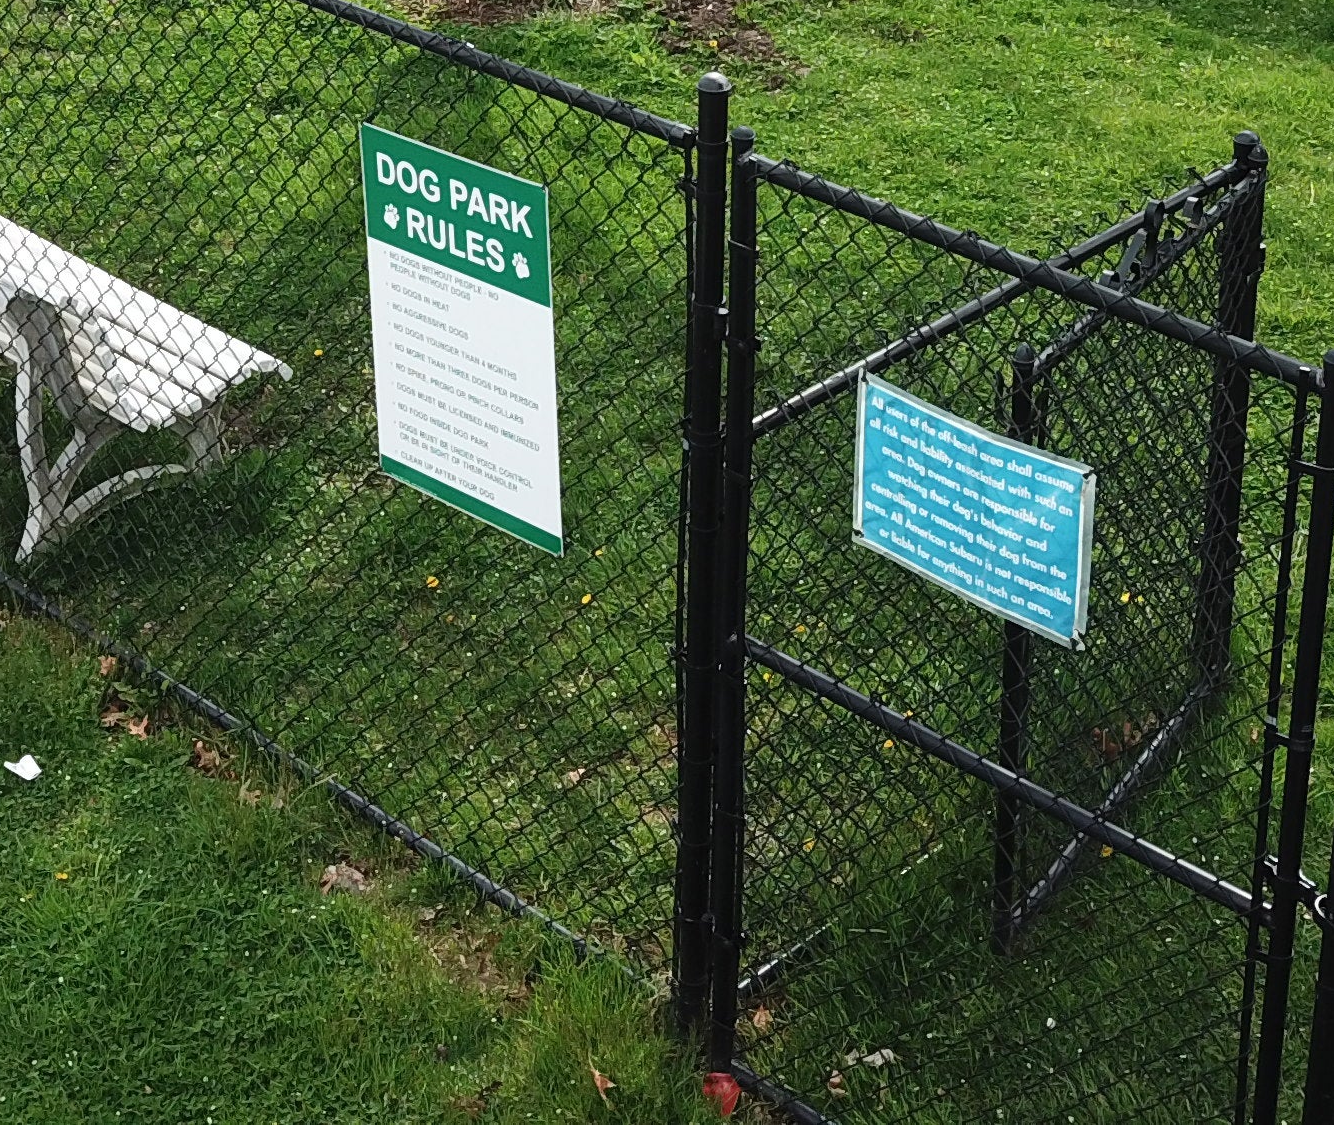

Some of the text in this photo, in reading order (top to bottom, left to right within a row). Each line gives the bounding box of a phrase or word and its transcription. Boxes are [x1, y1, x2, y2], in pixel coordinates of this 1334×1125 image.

[376, 151, 533, 239] DOG PARK
[406, 206, 505, 273] RULES
[870, 418, 881, 430] all
[883, 424, 898, 439] risk
[901, 435, 918, 449] and
[955, 462, 1005, 491] associated
[1008, 486, 1031, 499] with
[1035, 495, 1057, 510] such
[1058, 505, 1073, 517] an
[872, 396, 884, 410] All
[886, 406, 908, 423] users
[910, 417, 920, 428] of
[921, 421, 936, 436] the
[980, 453, 1004, 468] area
[1007, 460, 1032, 477] shall
[1035, 473, 1075, 493] assume
[871, 483, 1067, 580] controlling or removing their dog from the
[888, 470, 928, 499] watching
[930, 489, 950, 507] their
[981, 513, 1023, 542] behavior
[1026, 538, 1047, 552] and
[907, 456, 926, 477] Dog
[928, 470, 961, 492] owners
[963, 487, 979, 500] are
[981, 496, 1038, 526] responsible
[1040, 517, 1055, 532] for
[879, 529, 889, 538] or
[891, 531, 916, 553] liable
[917, 545, 930, 560] for
[932, 557, 973, 585] anything
[975, 576, 984, 588] in
[987, 584, 1008, 599] such
[1011, 595, 1025, 606] an
[891, 512, 903, 525] All
[905, 519, 947, 548] American
[950, 542, 983, 566] Subaru
[985, 559, 993, 571] is
[995, 567, 1012, 579] not
[1014, 575, 1072, 605] responsible
